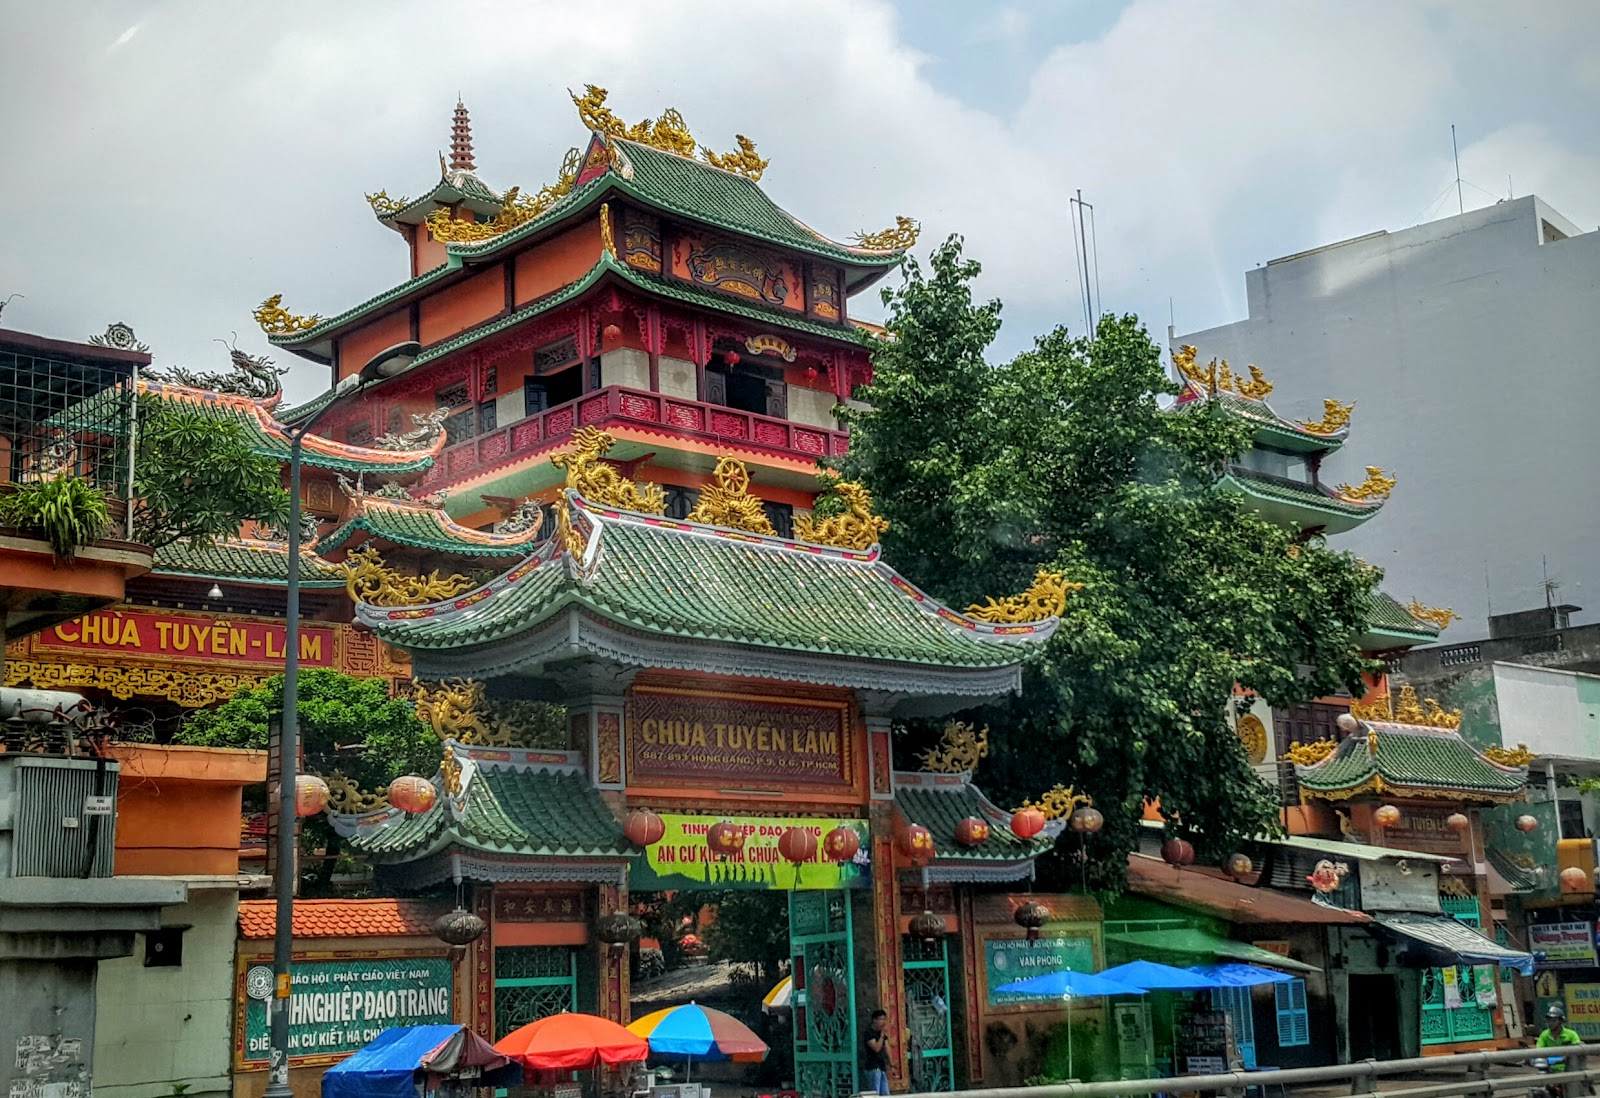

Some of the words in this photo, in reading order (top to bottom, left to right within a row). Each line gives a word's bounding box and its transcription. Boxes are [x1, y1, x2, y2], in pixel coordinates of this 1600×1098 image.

[54, 611, 142, 647] CHÙA
[155, 621, 322, 661] TUYỀN-LM
[642, 715, 706, 747] CHÙA
[792, 724, 838, 755] LÂM
[657, 845, 676, 863] AN
[679, 843, 697, 863] CƯ
[290, 972, 308, 984] IÁO
[311, 972, 329, 986] HỘI
[333, 970, 360, 984] PHẬT
[361, 969, 384, 980] GIÁO
[386, 969, 407, 982] VIỆT
[409, 969, 430, 979] NAM
[364, 990, 397, 1025] ĐẠO
[397, 981, 448, 1017] TRÀNG
[301, 1031, 317, 1047] CƯ
[318, 1024, 343, 1046] KIẾT
[346, 1030, 361, 1046] HẠ
